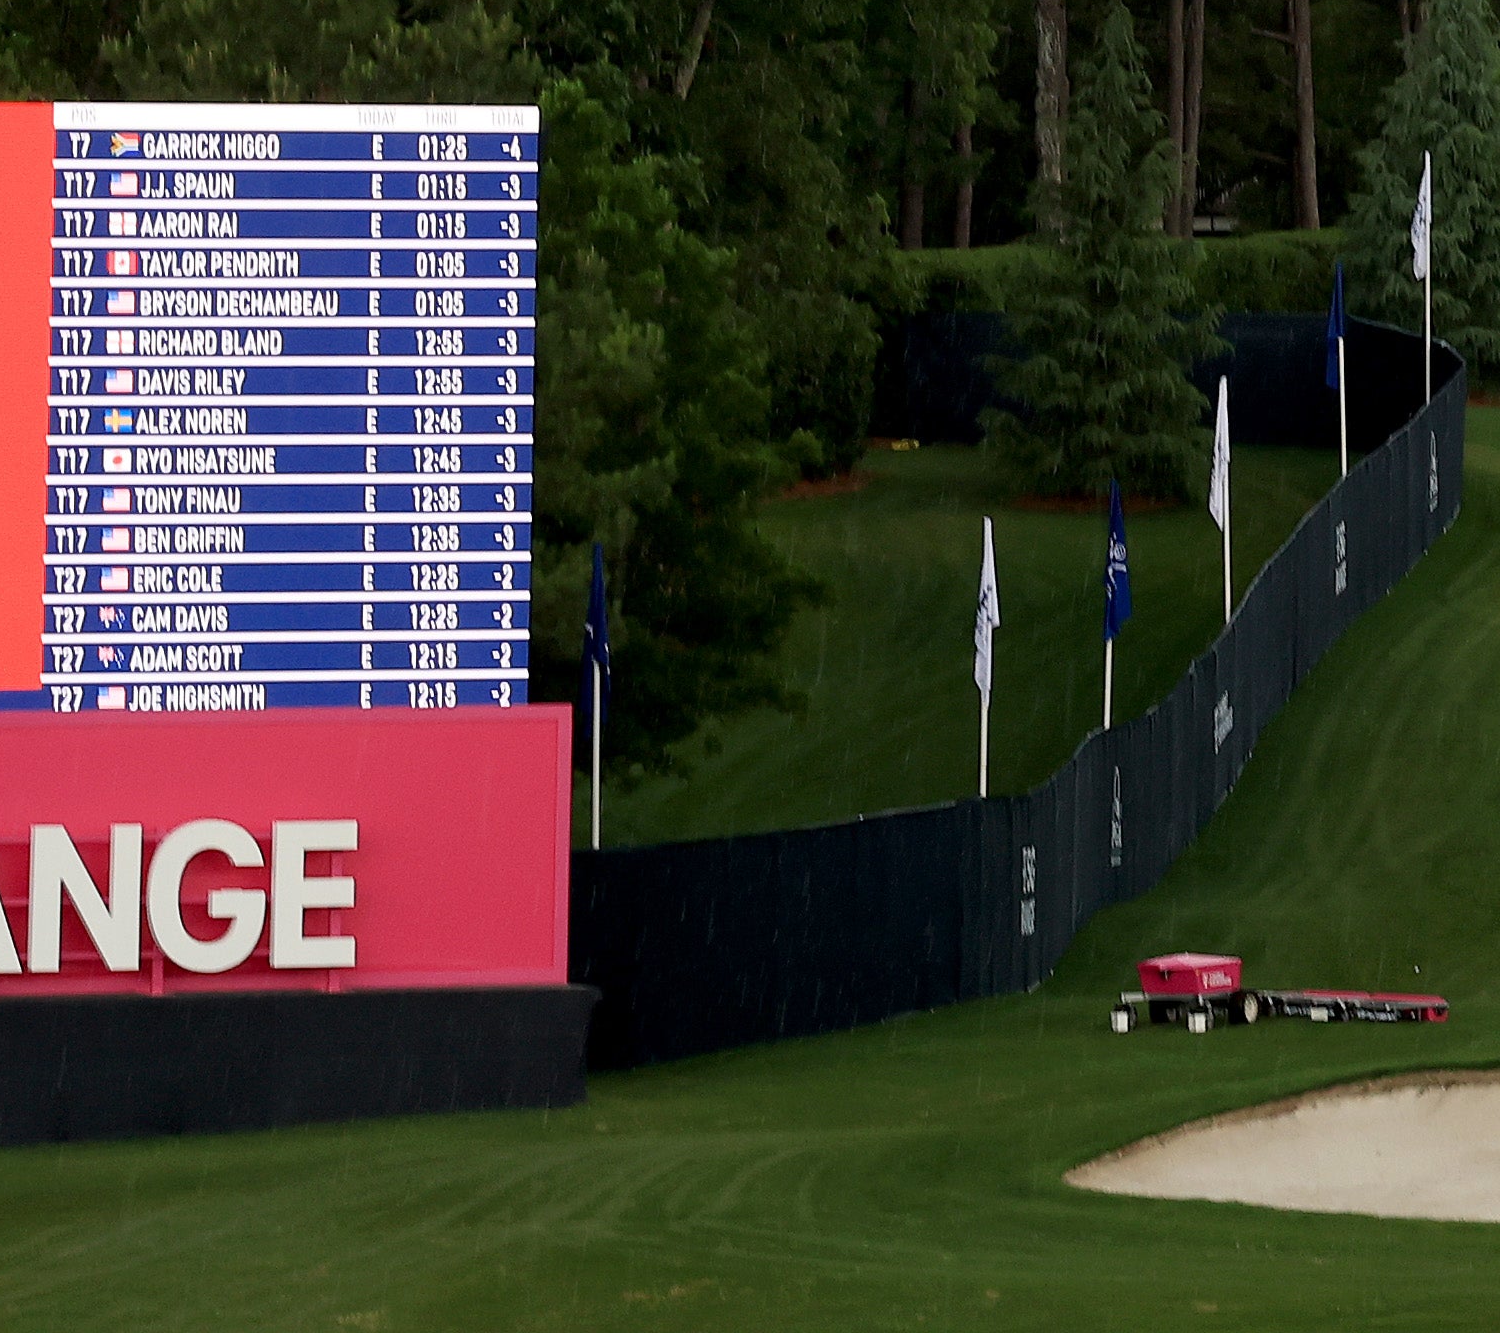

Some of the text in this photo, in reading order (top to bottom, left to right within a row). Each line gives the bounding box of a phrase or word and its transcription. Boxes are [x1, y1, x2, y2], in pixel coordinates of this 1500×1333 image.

[69, 131, 520, 162] T7 GARRICK HIGGO E 01:25 -4
[63, 171, 520, 201] T17 J.J. SPAUN E 01:15 -3
[62, 210, 519, 240] T17 AARON RAI E 01:15 -3
[61, 250, 518, 279] T17 TAYLOR PENDRITH E 01:05 -3
[60, 289, 518, 318] T17 BRYSON DECHAMBEAU E 01:05 -3
[59, 329, 517, 357] T17 RICHARD BLAND E 12:55 -3
[59, 368, 516, 396] T17 DAVIS RILEY E 12:55 -3
[58, 408, 515, 435] T17 ALEX NOREN E 12:45 -3
[57, 447, 514, 475] T17 RYO HISATSUNE E 12:45 -3
[56, 486, 514, 515] T17 TONY FINAU E 12:35 -3
[55, 525, 513, 554] T17 BEN GRIFFIN E 12:35 -3
[54, 564, 512, 594] T27 ERIC COLE E 12:25 -2
[53, 603, 512, 633] T27 CAM DAVIS E 12:25 -2
[52, 642, 511, 673] T27 ADAM SCOTT E 12:15 -2
[52, 682, 510, 713] T27 JOE HIGHSMITH E 12:15 -2
